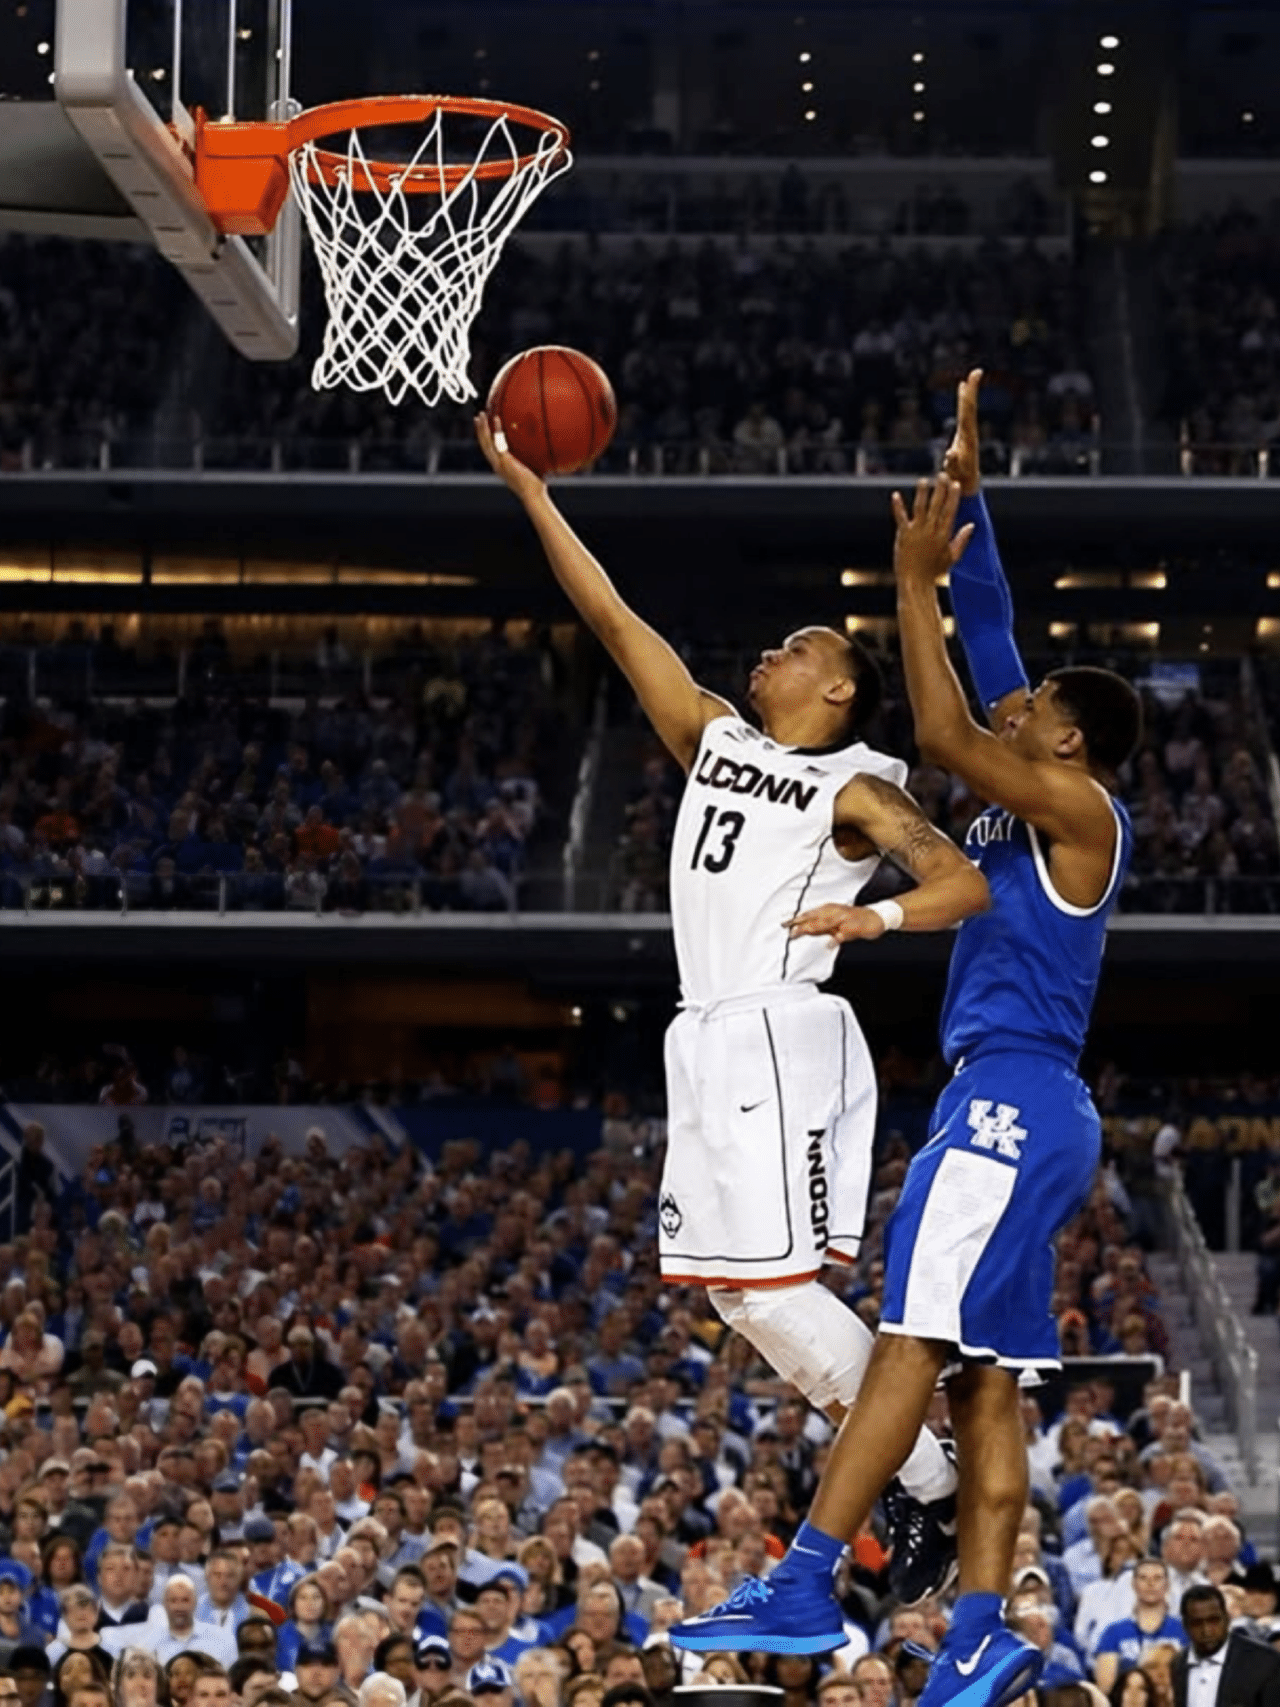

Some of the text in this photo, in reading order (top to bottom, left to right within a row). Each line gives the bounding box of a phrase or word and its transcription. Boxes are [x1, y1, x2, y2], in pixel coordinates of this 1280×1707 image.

[695, 749, 819, 812] UCONN
[691, 805, 745, 873] 13
[967, 1099, 1028, 1161] UK
[807, 1128, 829, 1251] UCONN
